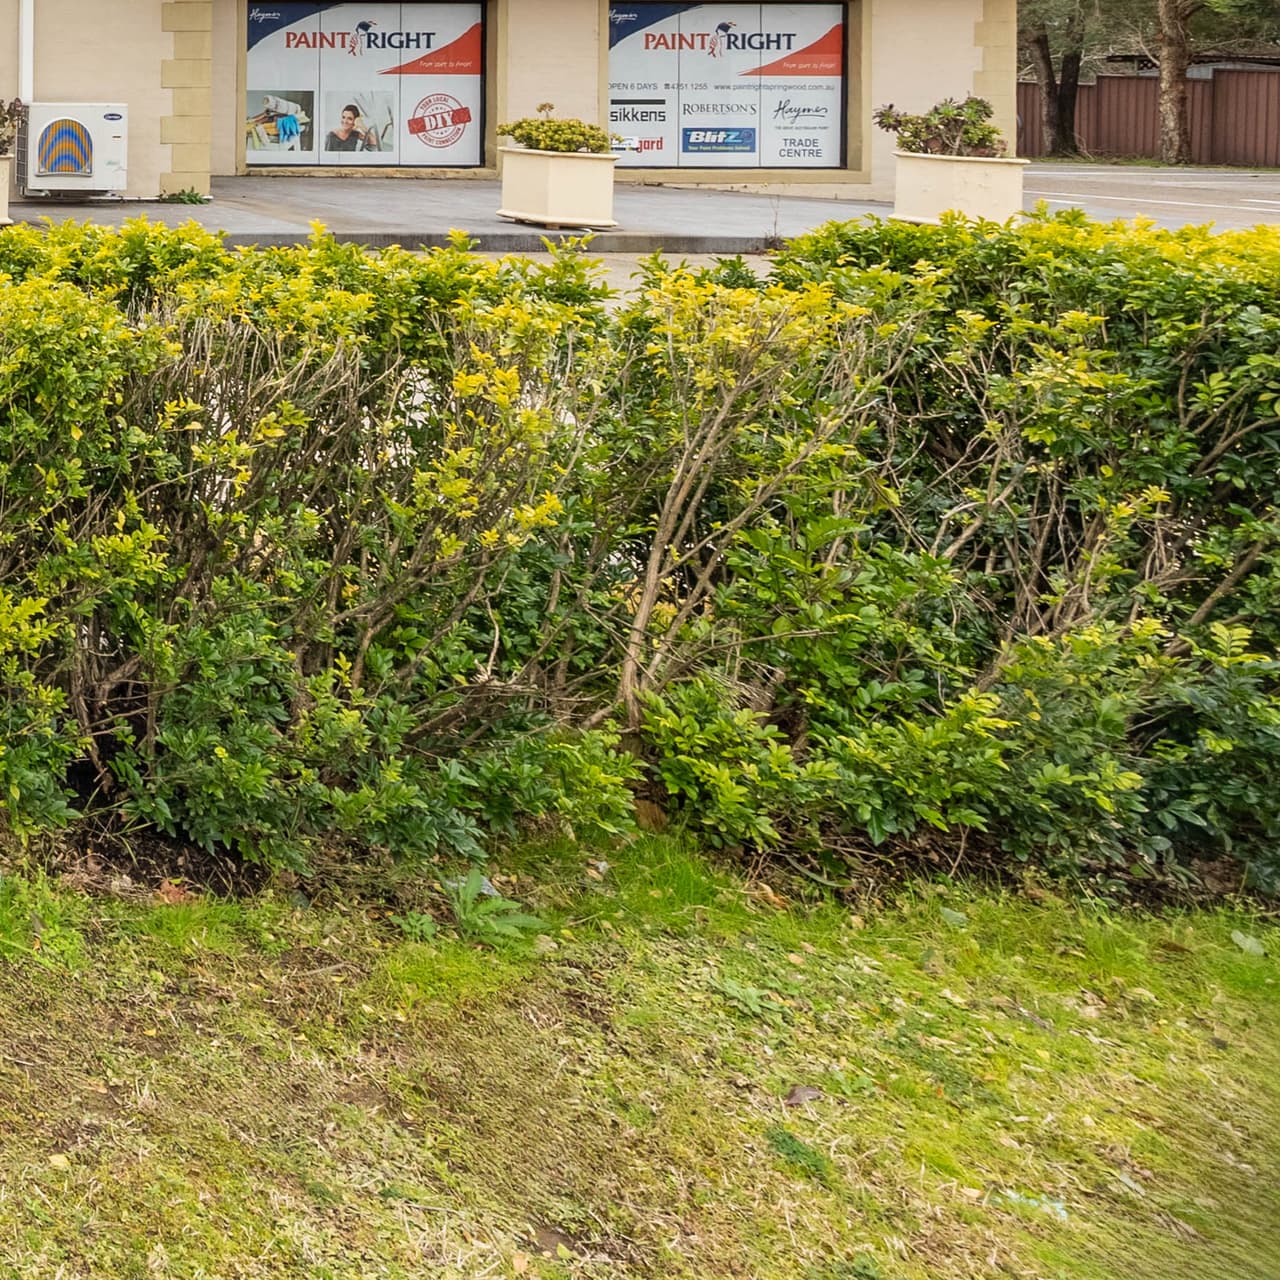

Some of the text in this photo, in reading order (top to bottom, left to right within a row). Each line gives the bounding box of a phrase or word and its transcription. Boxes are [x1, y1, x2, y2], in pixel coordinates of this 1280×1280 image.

[285, 31, 436, 49] PAINT RIGHT
[644, 33, 797, 50] PAINT RIGHT
[609, 107, 666, 122] sikkens
[773, 99, 828, 124] Haymes
[424, 111, 454, 131] DIY
[782, 138, 820, 147] TRADE
[779, 148, 823, 157] CENTRE
